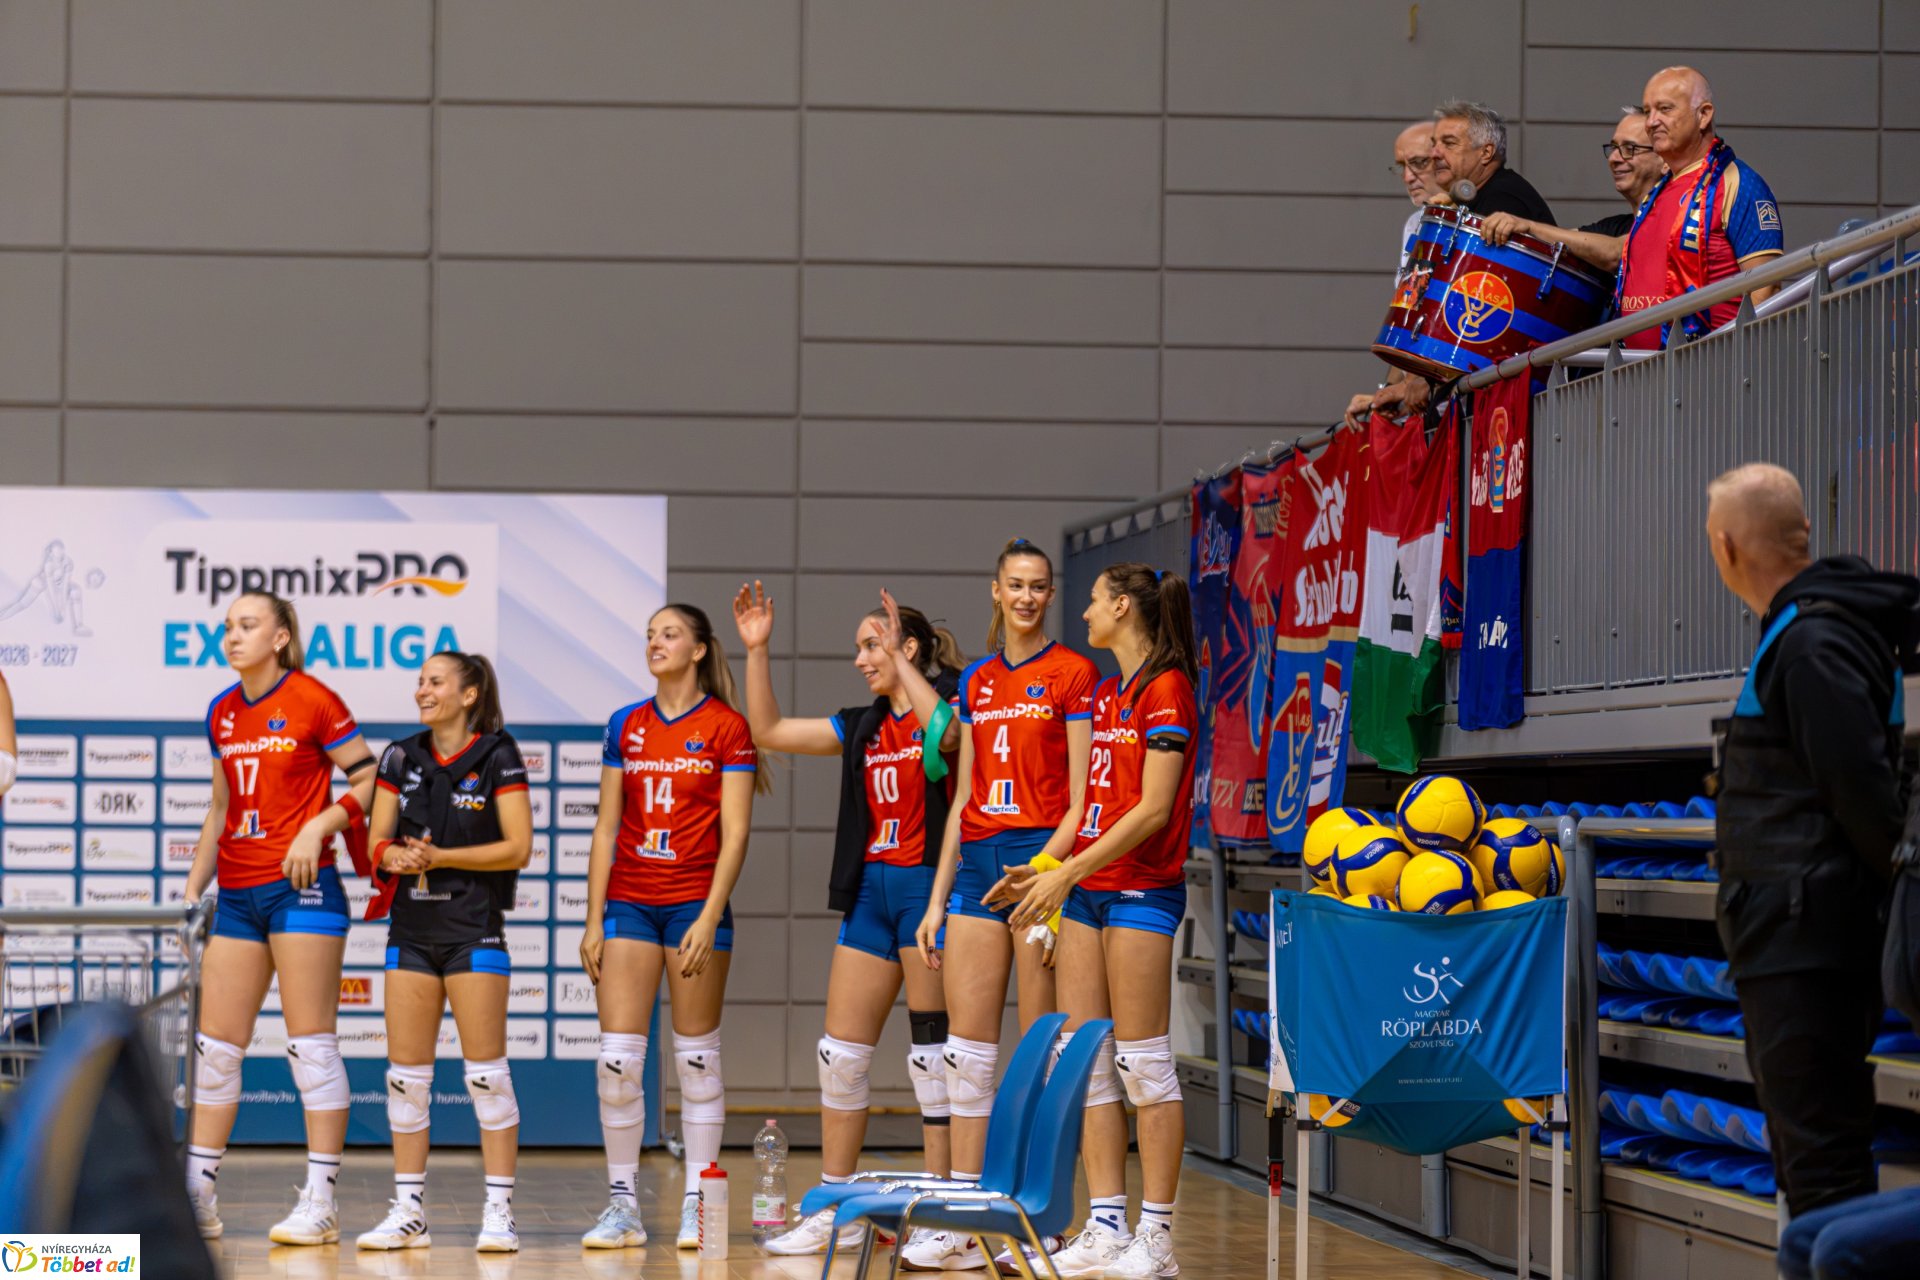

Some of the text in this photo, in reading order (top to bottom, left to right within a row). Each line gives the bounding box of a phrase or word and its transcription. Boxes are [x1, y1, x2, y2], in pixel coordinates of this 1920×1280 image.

[166, 549, 469, 608] TippmixPRO
[163, 623, 463, 669] EXALIGA
[992, 724, 1011, 763] 4
[234, 757, 260, 796] 17
[873, 766, 900, 804] 10
[1089, 747, 1112, 788] 22
[643, 776, 676, 814] 14
[1417, 837, 1441, 846] V200W
[1381, 1018, 1483, 1038] RÖPLABDA
[1414, 1010, 1450, 1018] MAGYAR
[238, 1091, 296, 1105] nvolley.hu
